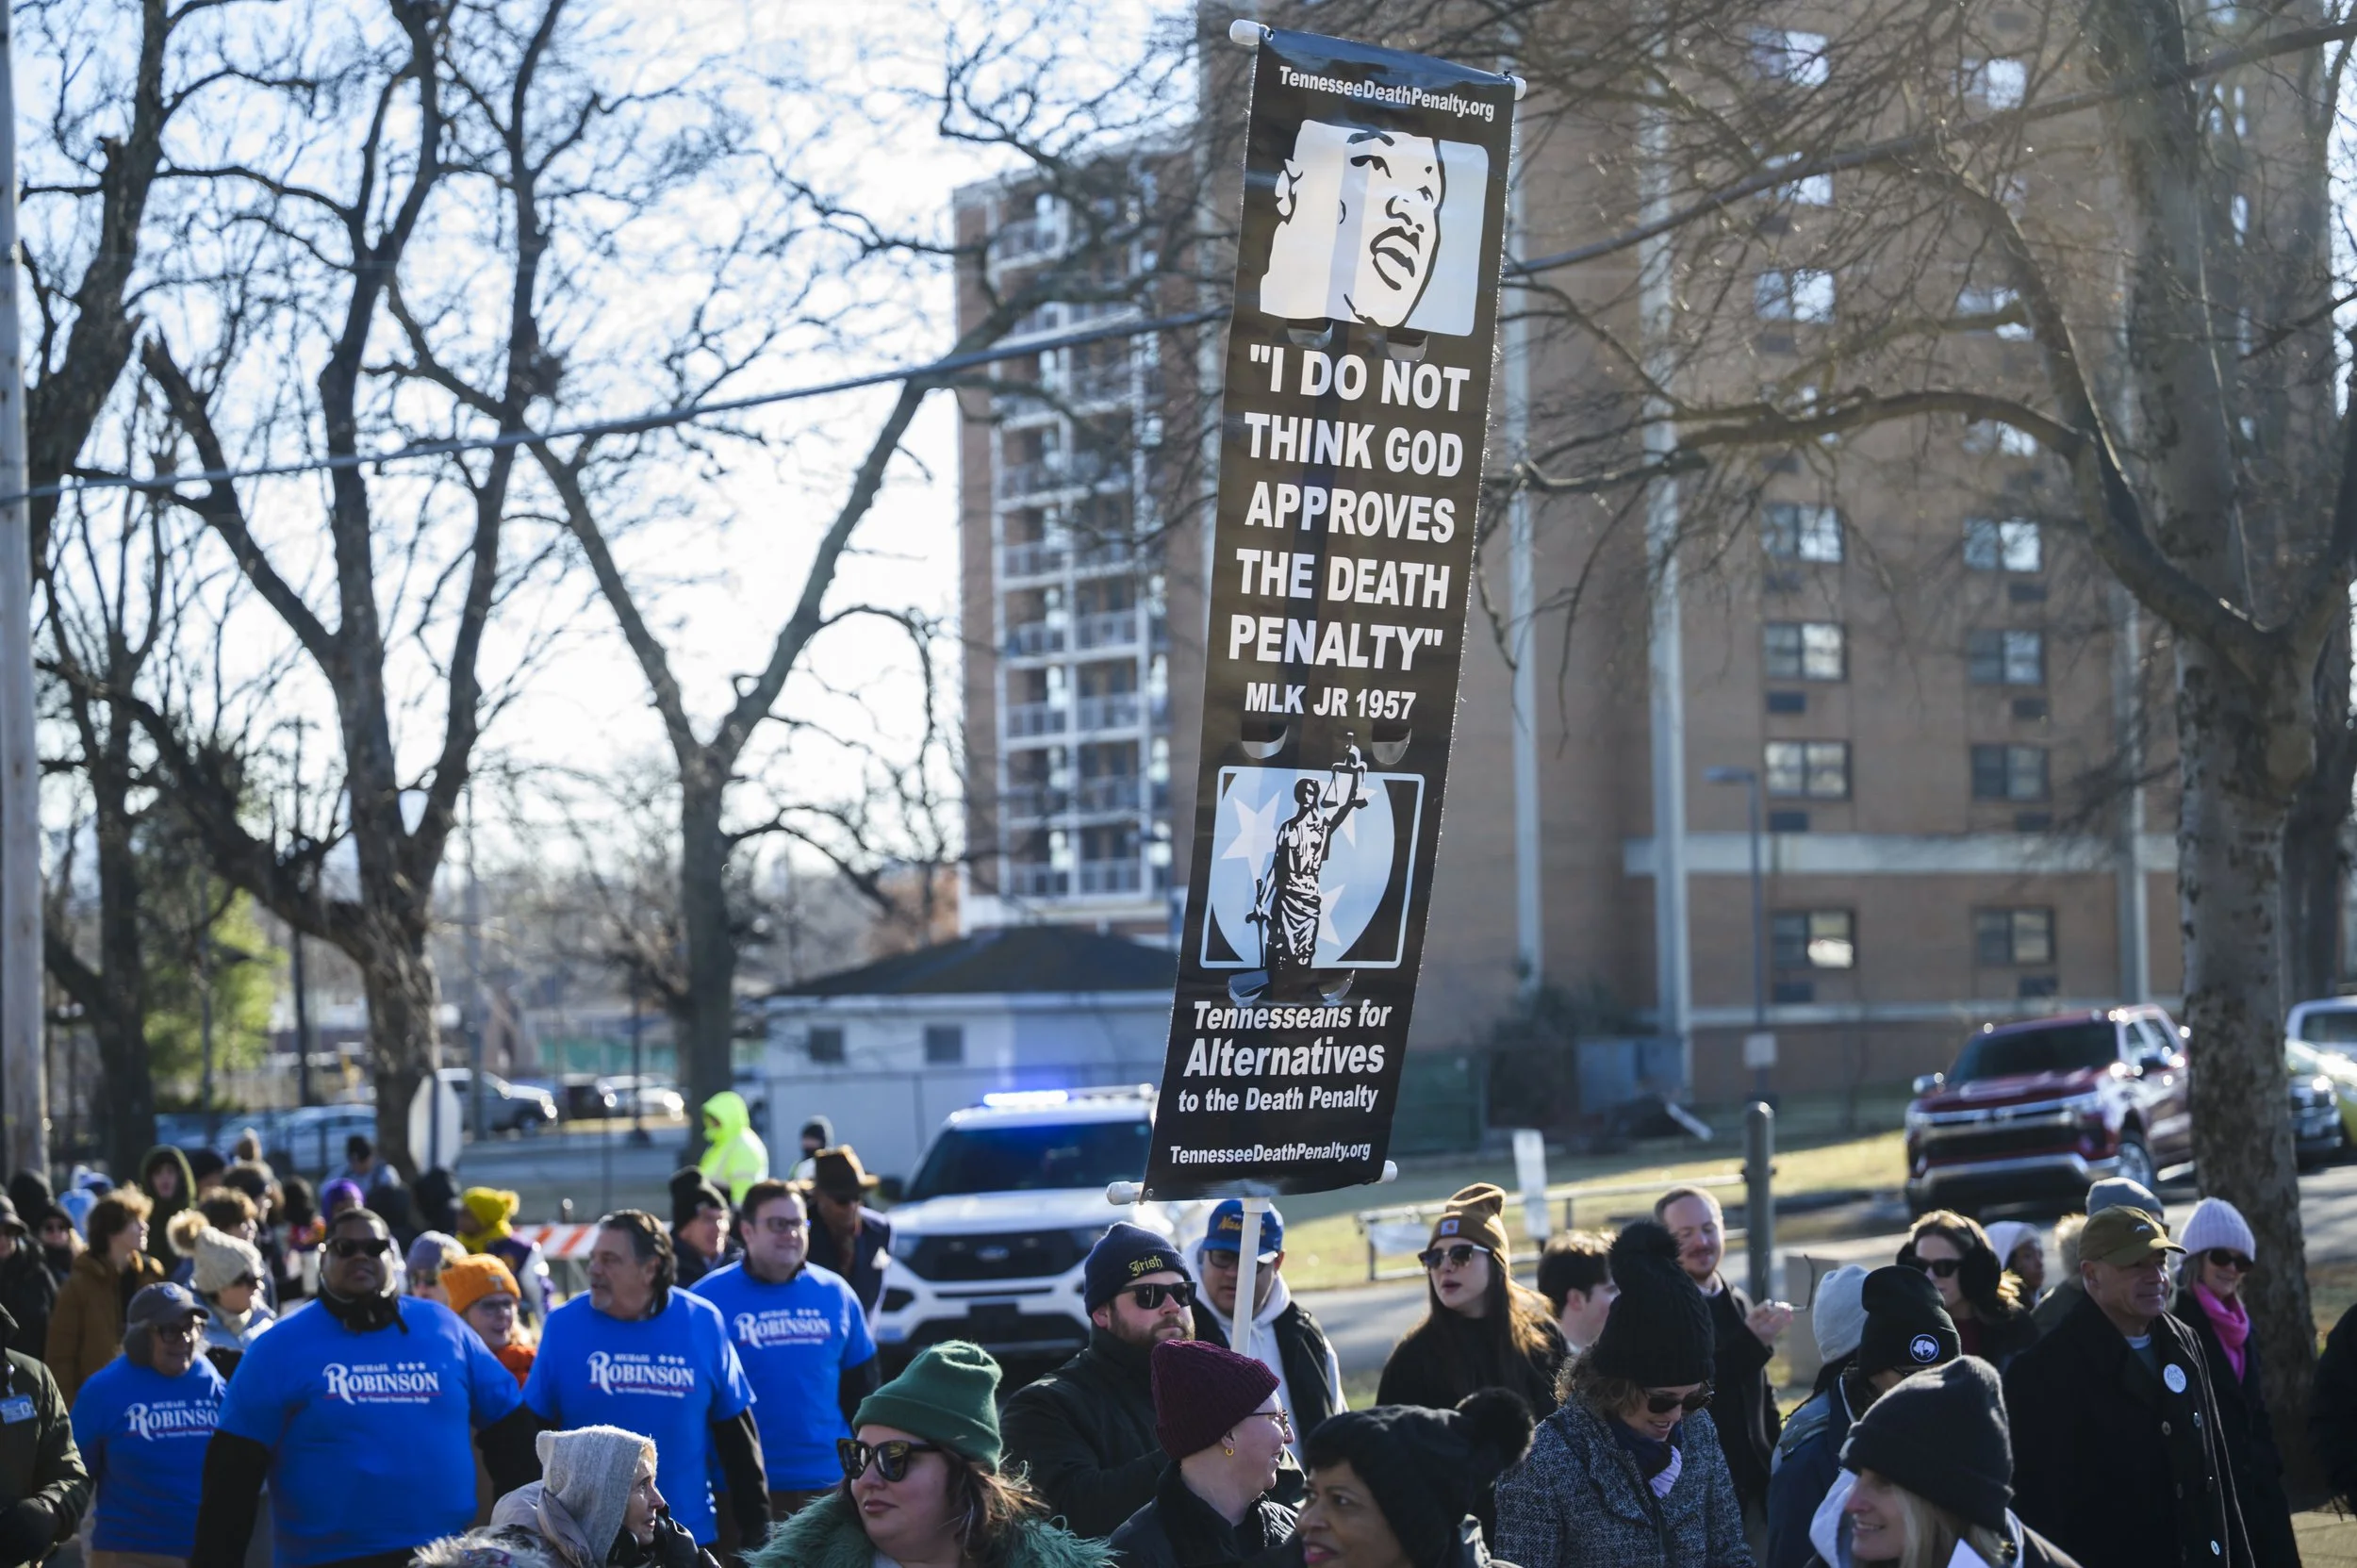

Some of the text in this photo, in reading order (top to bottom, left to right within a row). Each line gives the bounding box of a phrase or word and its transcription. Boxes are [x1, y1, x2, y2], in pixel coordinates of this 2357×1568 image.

[1279, 65, 1494, 123] TennesseeDeathPenalty.org
[1249, 343, 1471, 412] "I DO NOT
[1244, 411, 1463, 477] THINK GOD
[1244, 481, 1456, 543] APPROVES
[1236, 548, 1450, 609] THE DEATH
[1228, 614, 1443, 671] PENALTY"
[1244, 682, 1417, 720] MLK JR 1957
[1195, 999, 1393, 1030] Tennesseans for
[1183, 1036, 1385, 1078] Alternatives
[1178, 1084, 1378, 1113] to the Death Penalty
[1170, 1142, 1371, 1164] TennesseeDeathPenalty.org
[1129, 1255, 1163, 1277] Irish
[321, 1362, 439, 1406] ROBINSON
[586, 1350, 695, 1395] ROBINSON
